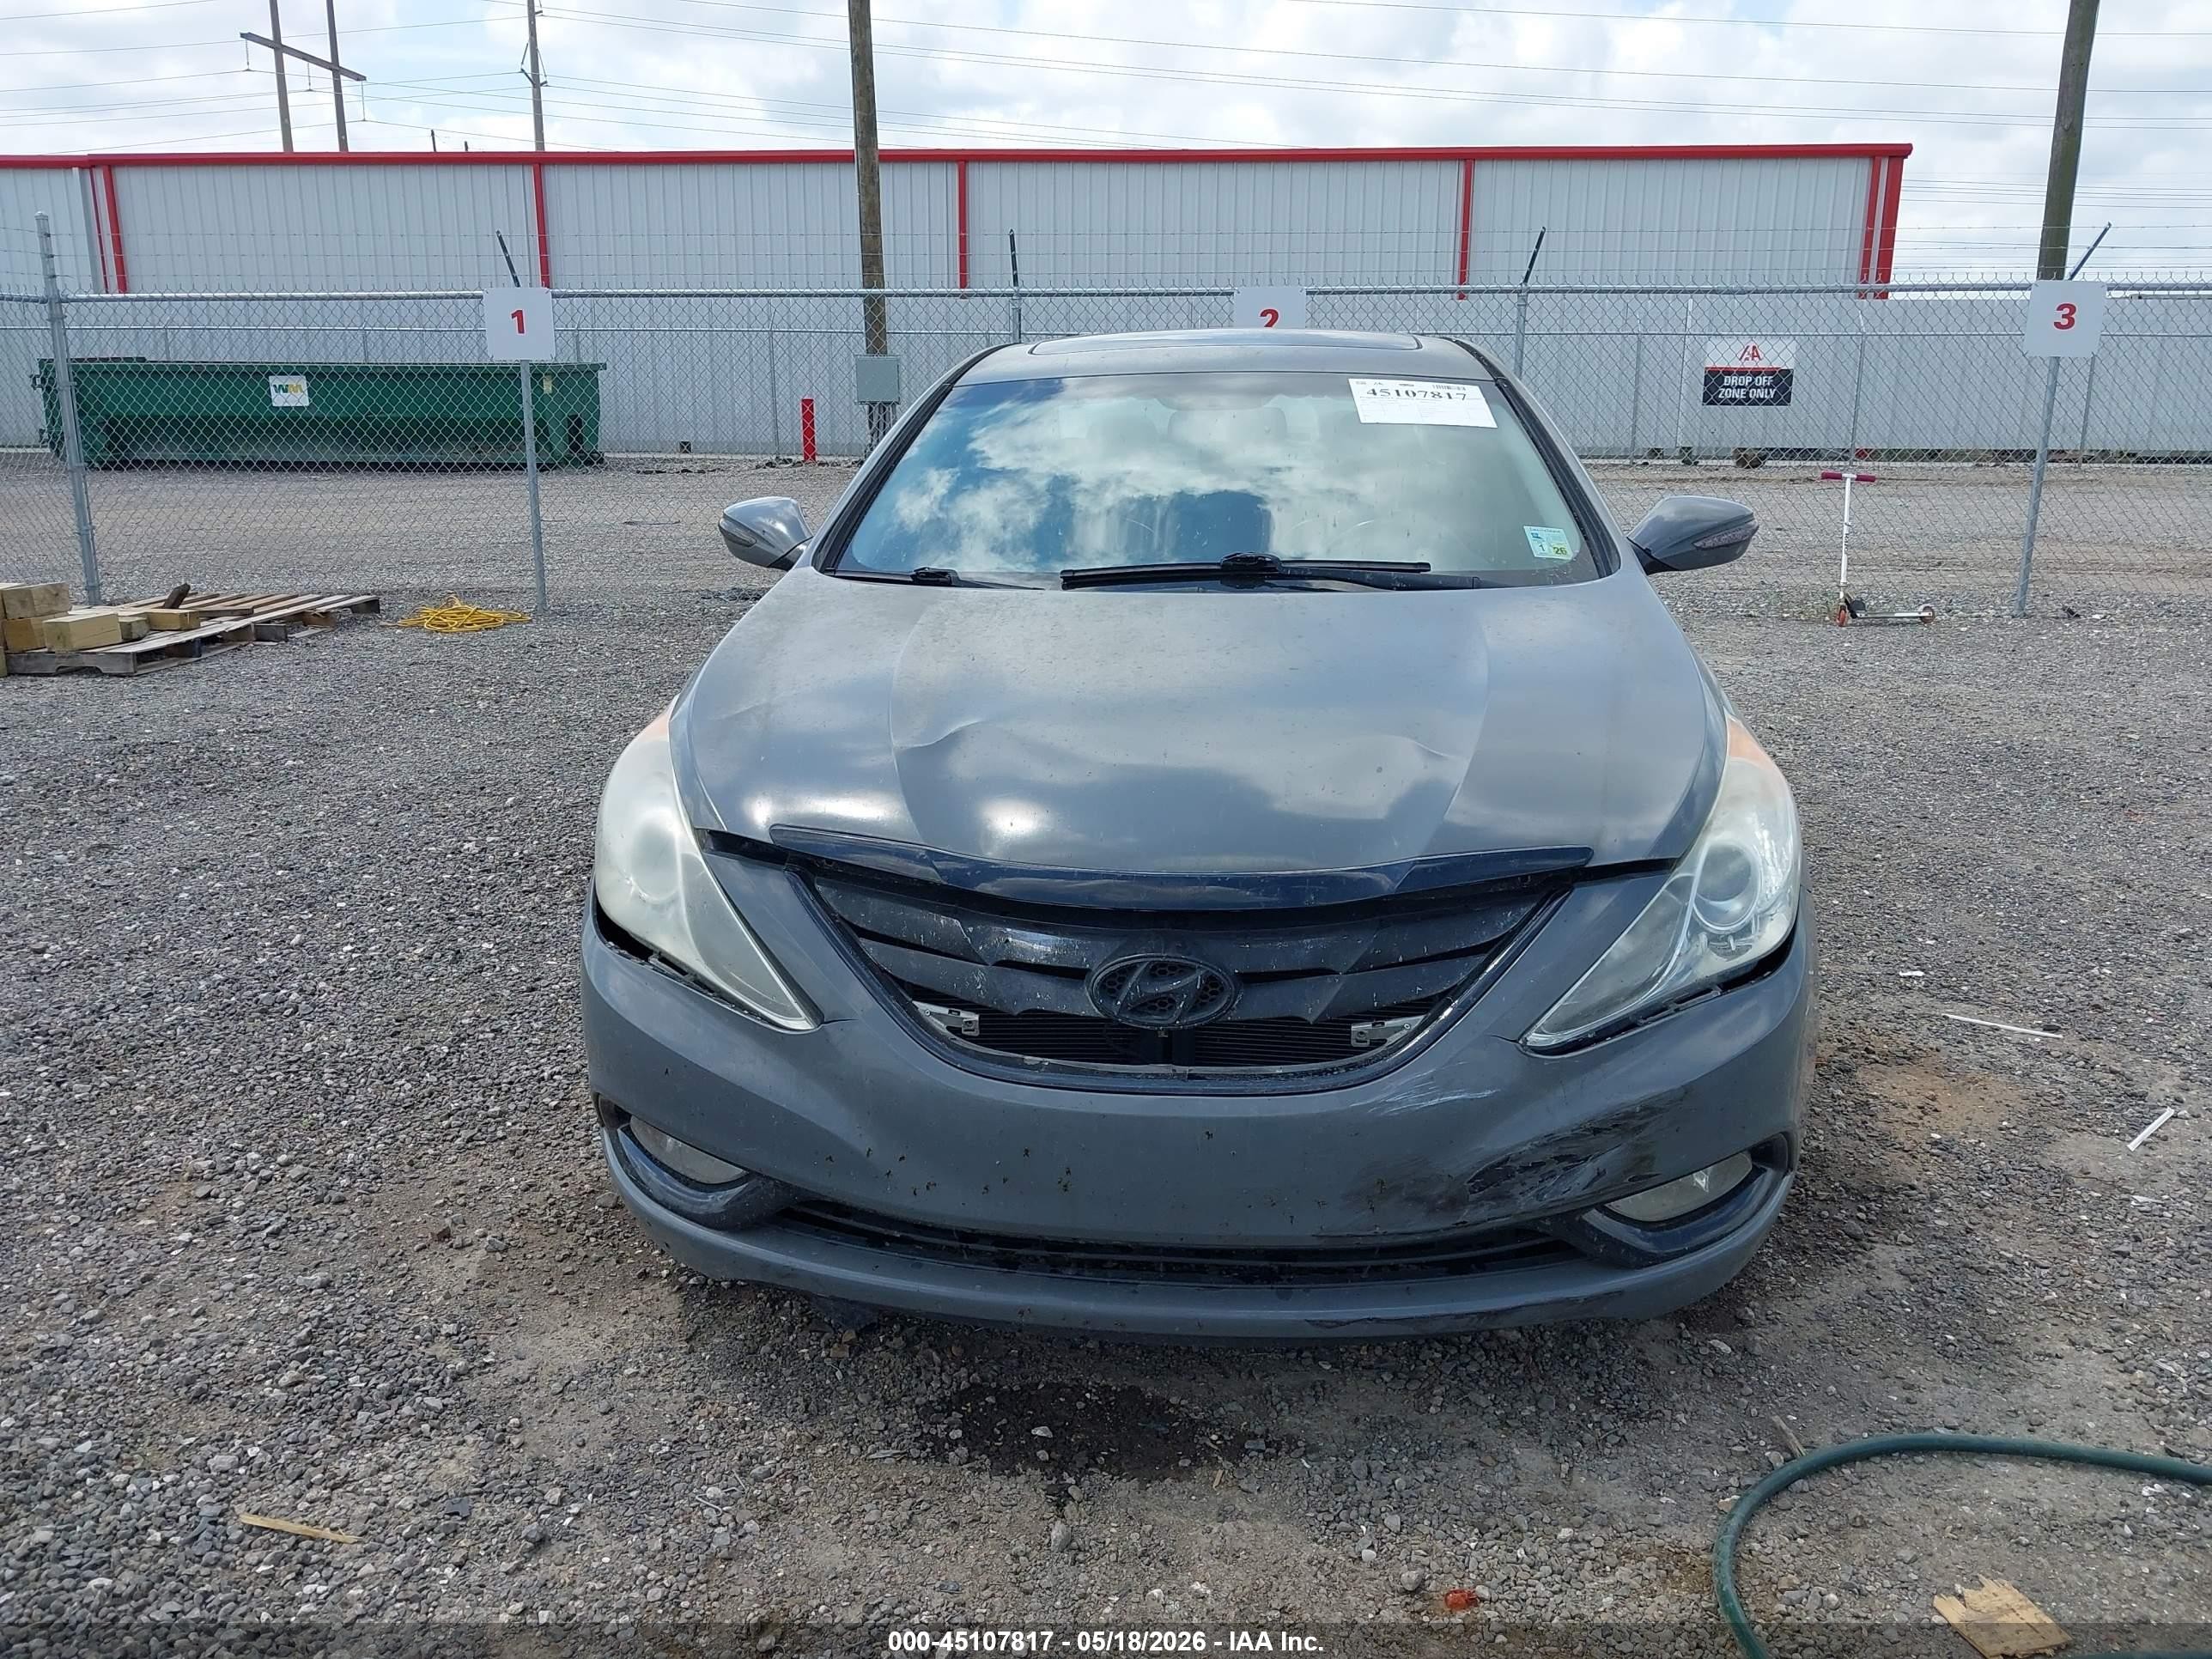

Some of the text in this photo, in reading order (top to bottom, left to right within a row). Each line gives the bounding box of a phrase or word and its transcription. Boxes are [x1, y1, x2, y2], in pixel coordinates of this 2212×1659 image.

[511, 309, 525, 334] 1
[1260, 308, 1279, 328] 2
[2053, 303, 2076, 330] 3
[1723, 376, 1773, 386] DROP OFF
[273, 384, 303, 393] WM
[1366, 387, 1467, 401] 45107817
[1718, 388, 1776, 398] ZONE ONLY
[1538, 544, 1546, 552] 1
